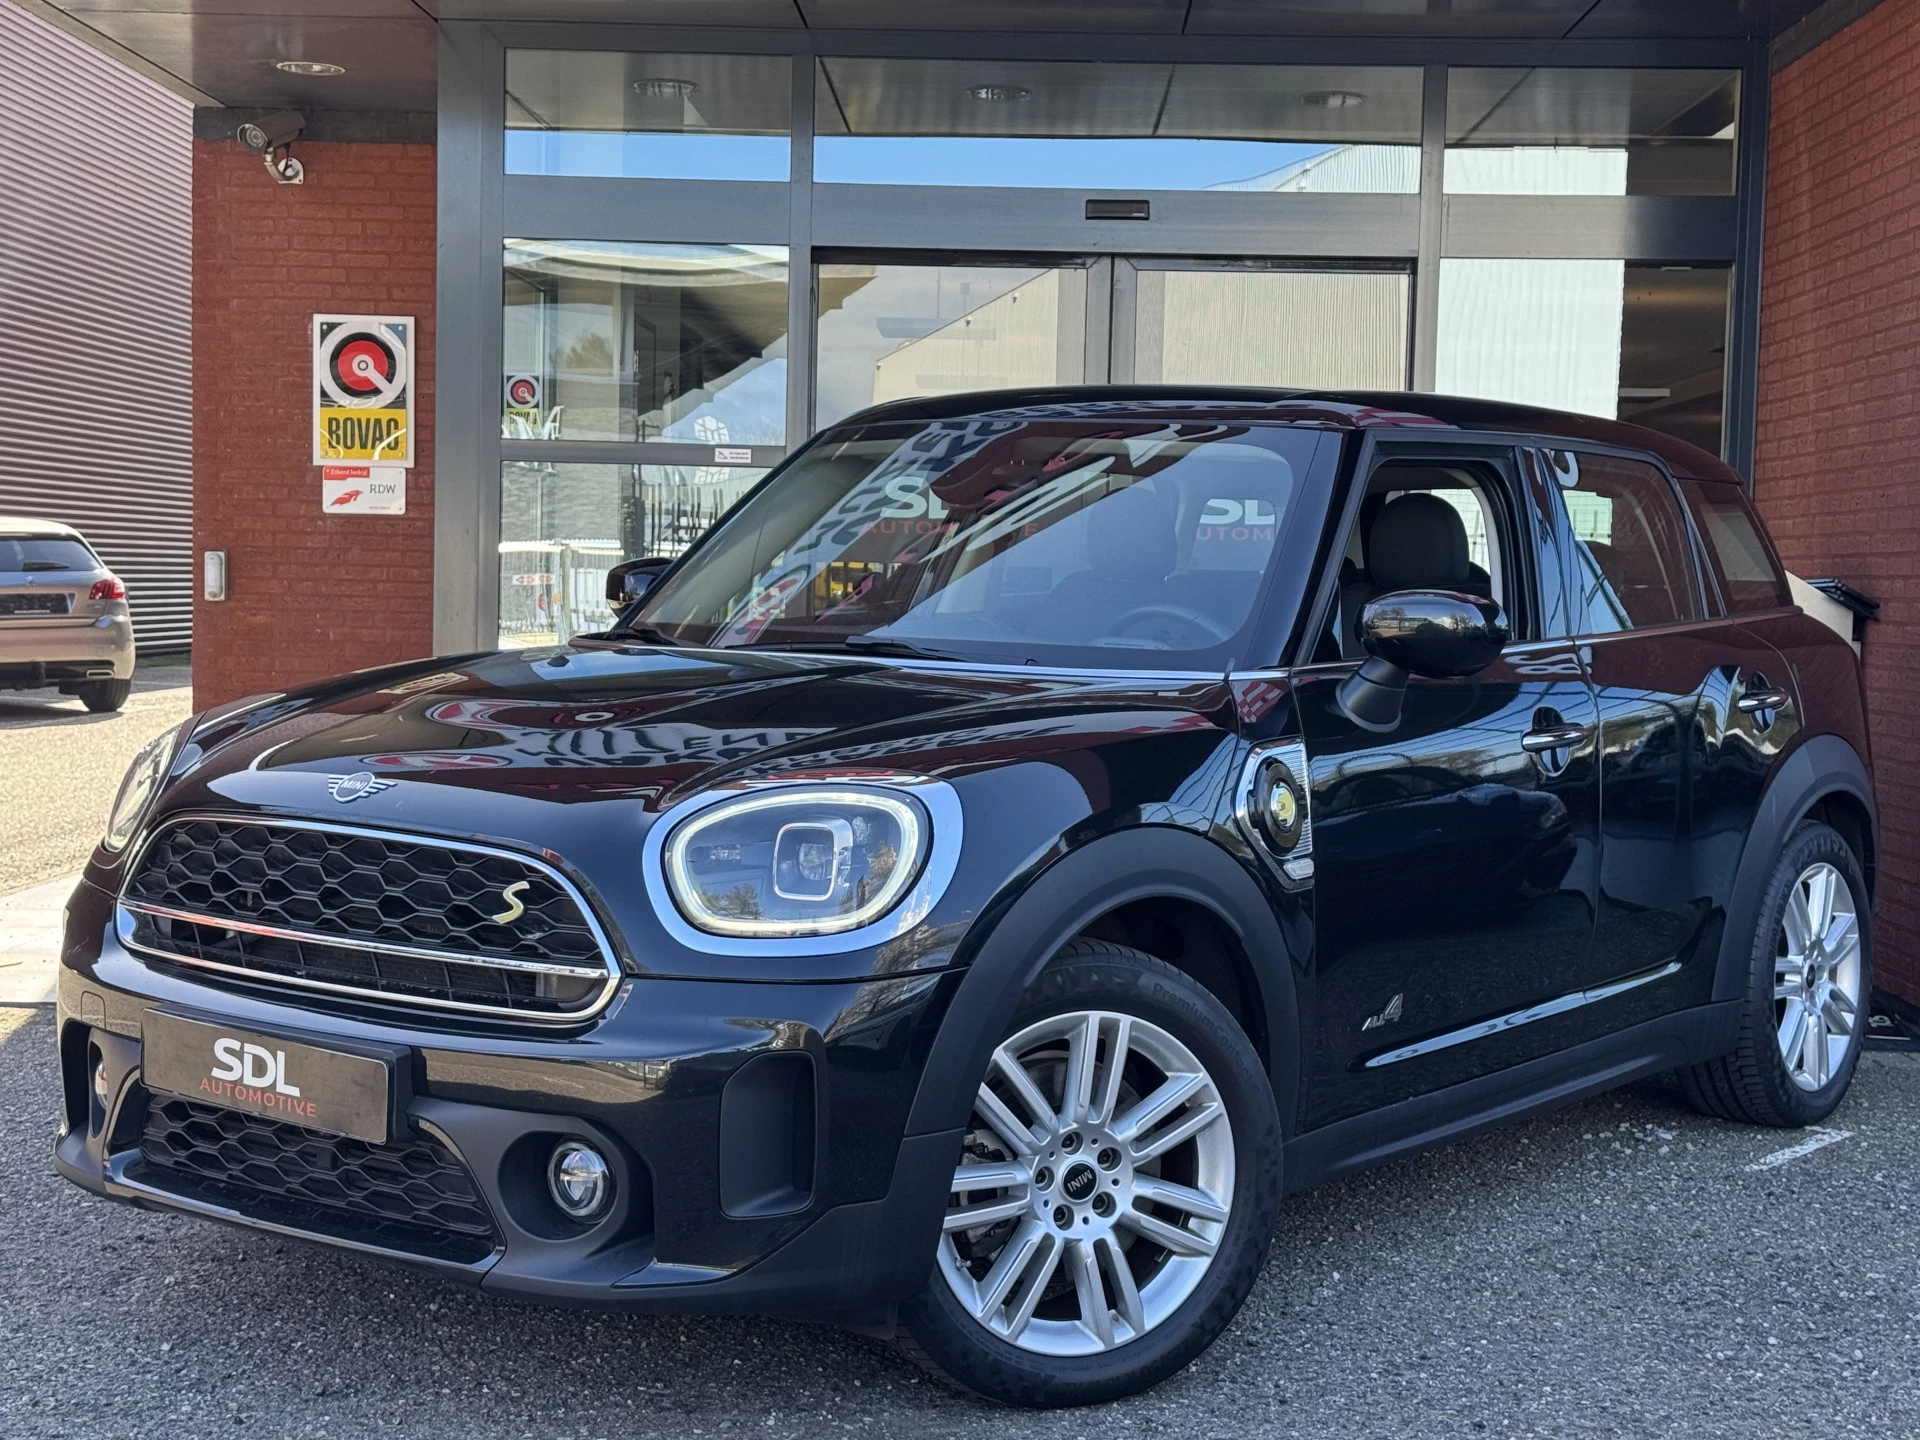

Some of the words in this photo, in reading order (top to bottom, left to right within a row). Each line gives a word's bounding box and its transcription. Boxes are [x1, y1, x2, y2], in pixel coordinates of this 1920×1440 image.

[369, 484, 396, 494] RDW
[340, 780, 369, 790] MINI
[492, 881, 531, 924] S
[211, 1037, 300, 1098] SDL
[199, 1077, 317, 1118] AUTOMOTIVE
[1067, 1169, 1093, 1193] MINI
